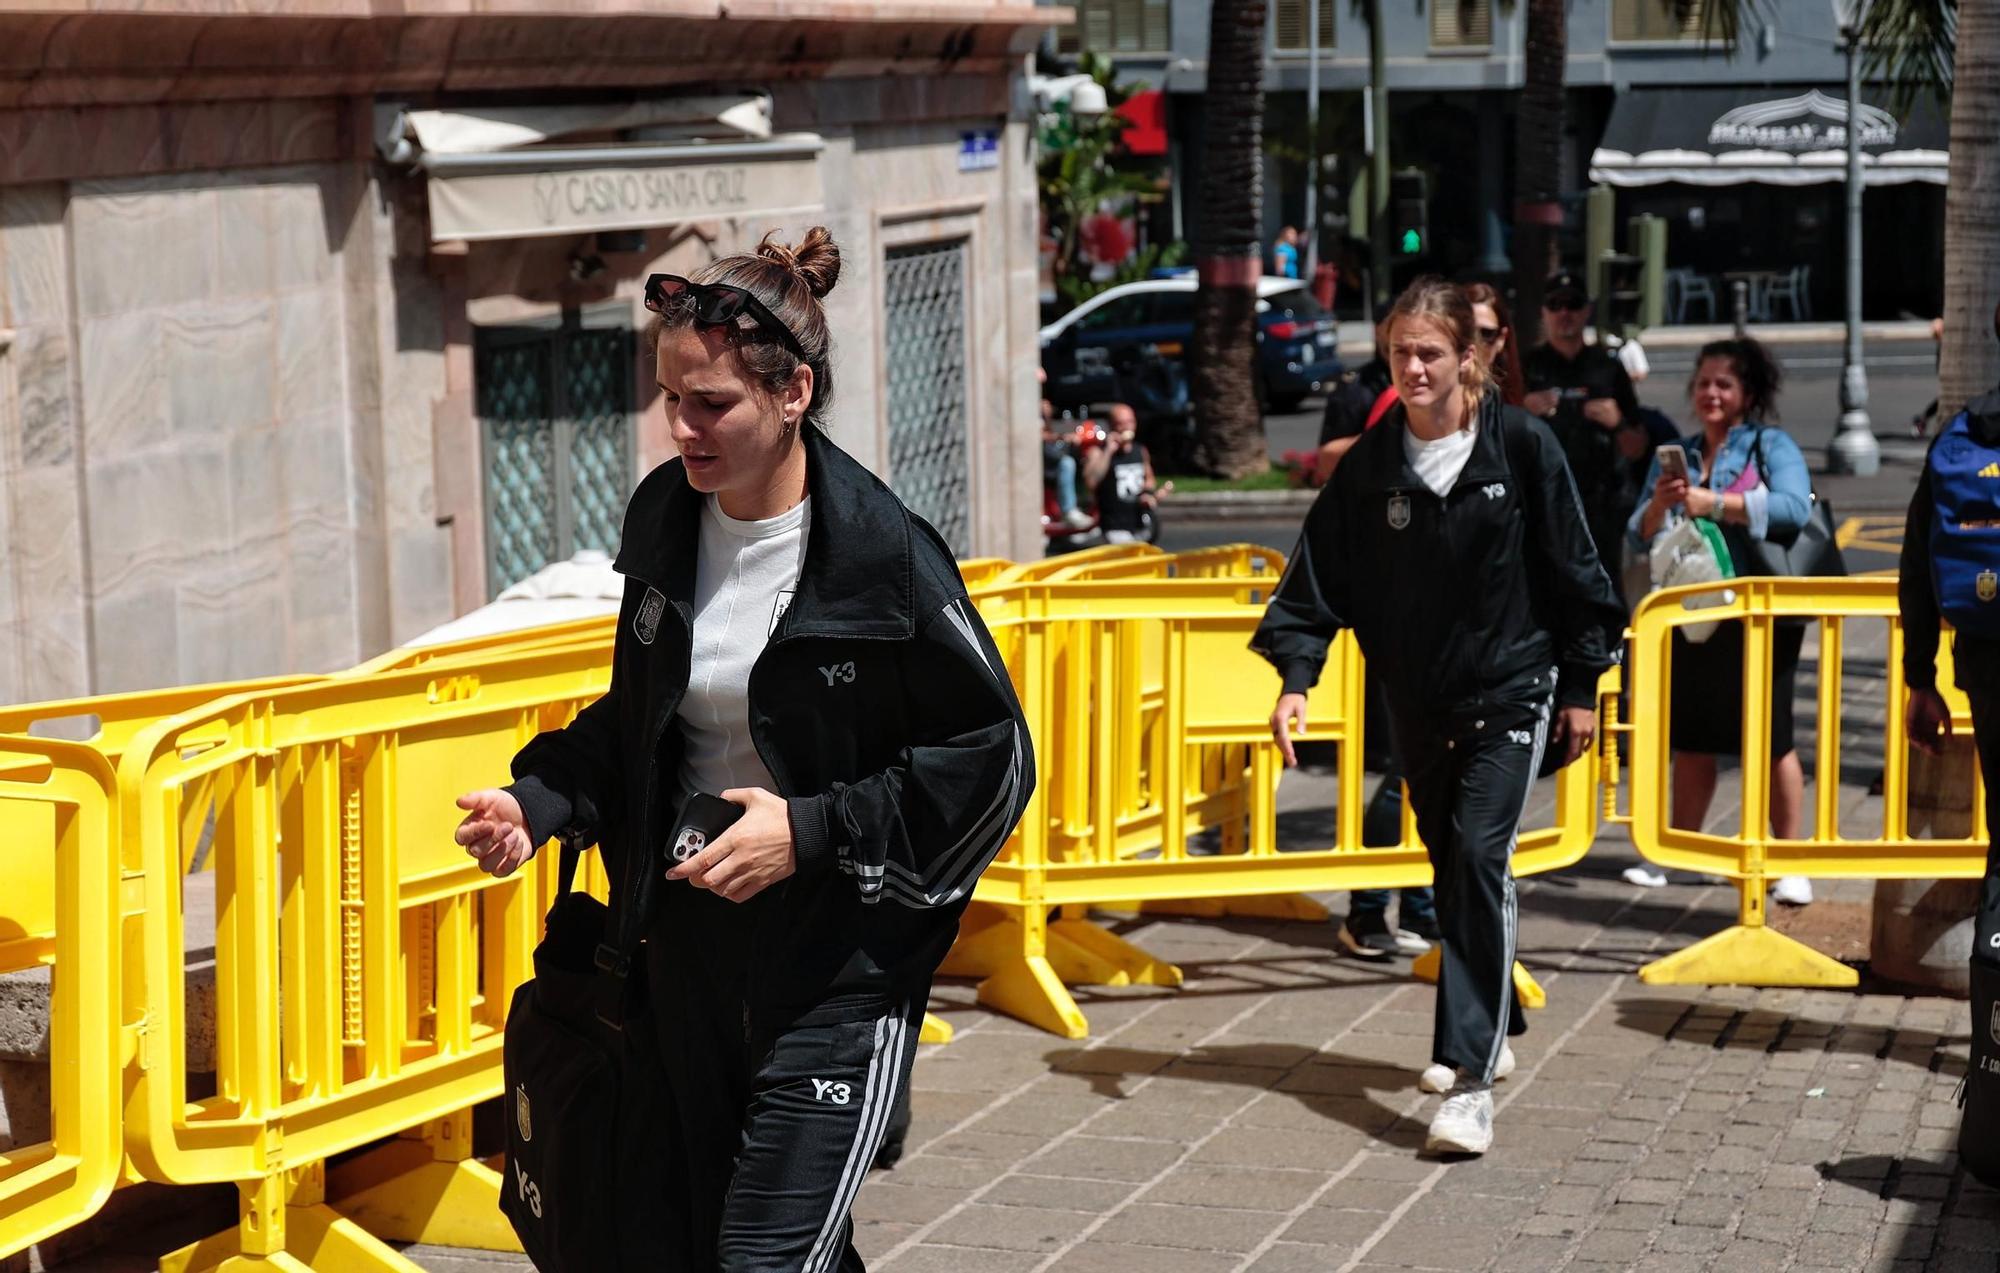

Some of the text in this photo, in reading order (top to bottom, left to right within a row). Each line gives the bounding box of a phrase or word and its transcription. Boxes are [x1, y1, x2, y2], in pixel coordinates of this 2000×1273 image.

[644, 171, 699, 209] SANTA
[703, 167, 746, 205] CRUZ
[818, 661, 857, 687] Y-3
[811, 1078, 851, 1105] Y-3
[514, 1158, 543, 1219] Y-3
